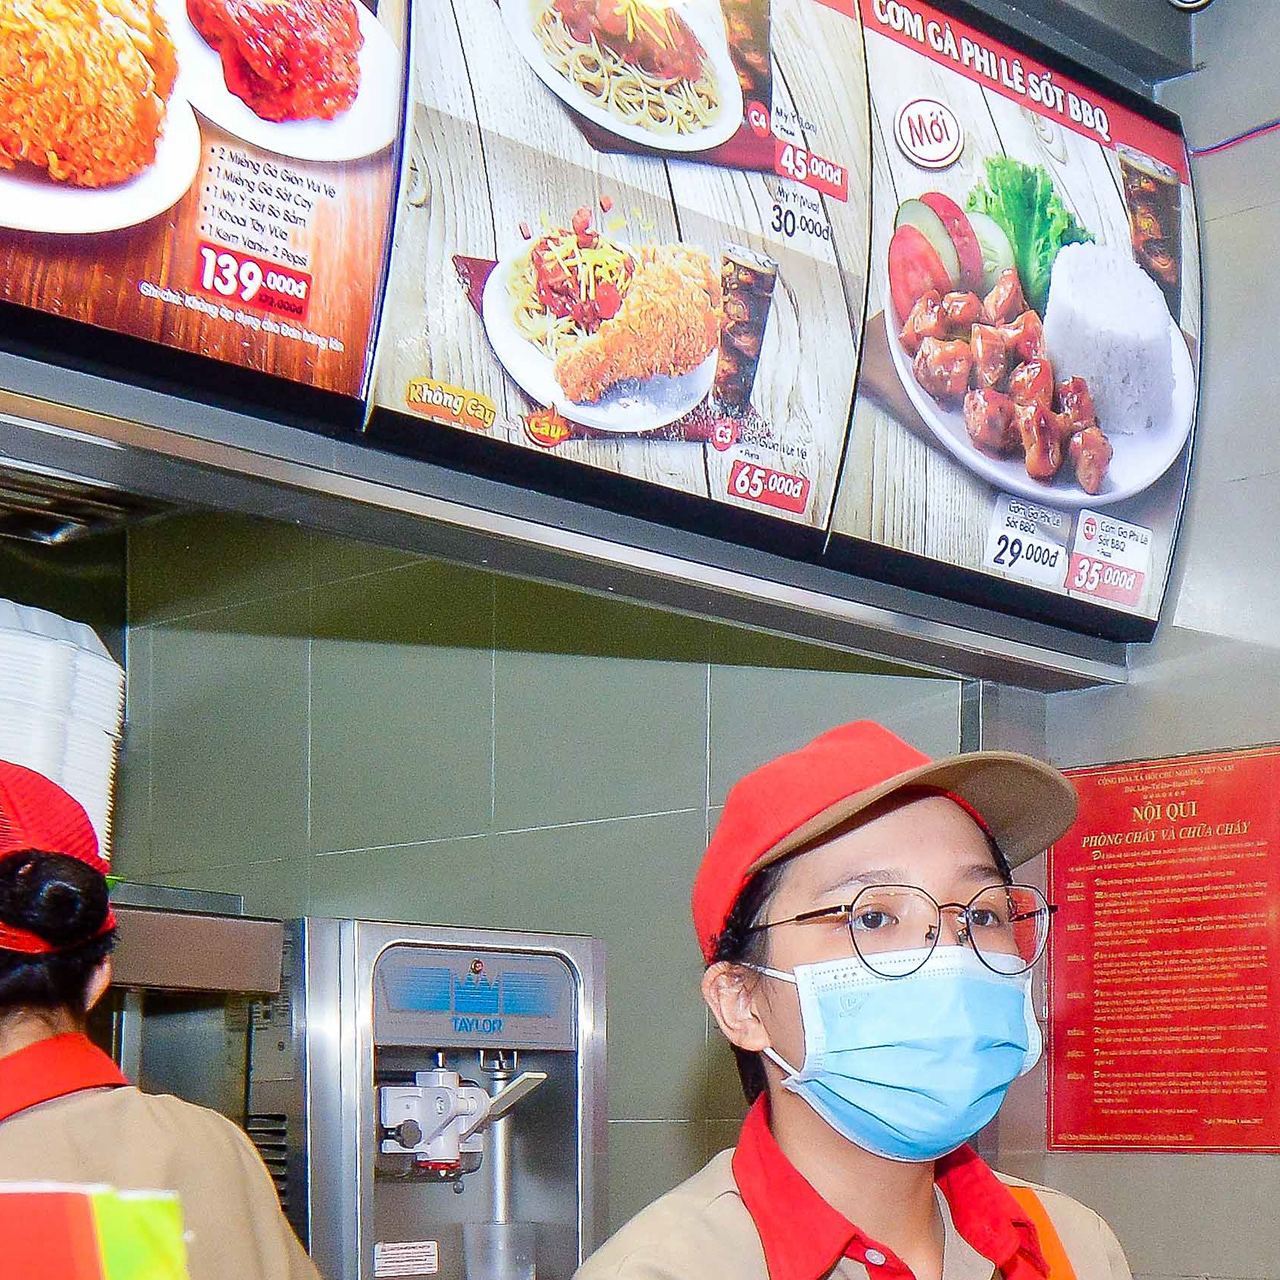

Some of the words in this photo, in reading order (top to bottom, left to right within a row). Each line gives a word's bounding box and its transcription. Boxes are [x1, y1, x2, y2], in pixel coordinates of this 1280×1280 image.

[872, 0, 925, 44] CƠM
[926, 19, 961, 62] GÀ
[960, 36, 999, 81] PHI
[999, 56, 1027, 95] LÊ
[1026, 70, 1066, 115] SỐT
[1067, 90, 1112, 143] BBQ
[907, 109, 951, 149] Mới
[780, 143, 844, 188] 45.000đ
[770, 203, 832, 241] 30.000đ
[200, 245, 309, 301] 139.000đ
[734, 464, 805, 500] 65.000đ
[992, 533, 1061, 569] 29.000đ
[1073, 556, 1137, 592] 35.000đ
[1131, 801, 1163, 825] NỘI
[1165, 800, 1198, 823] QUI
[1081, 830, 1123, 849] PHÒNG
[1216, 818, 1252, 837] CHÁY
[452, 1015, 503, 1034] TAYLOR
